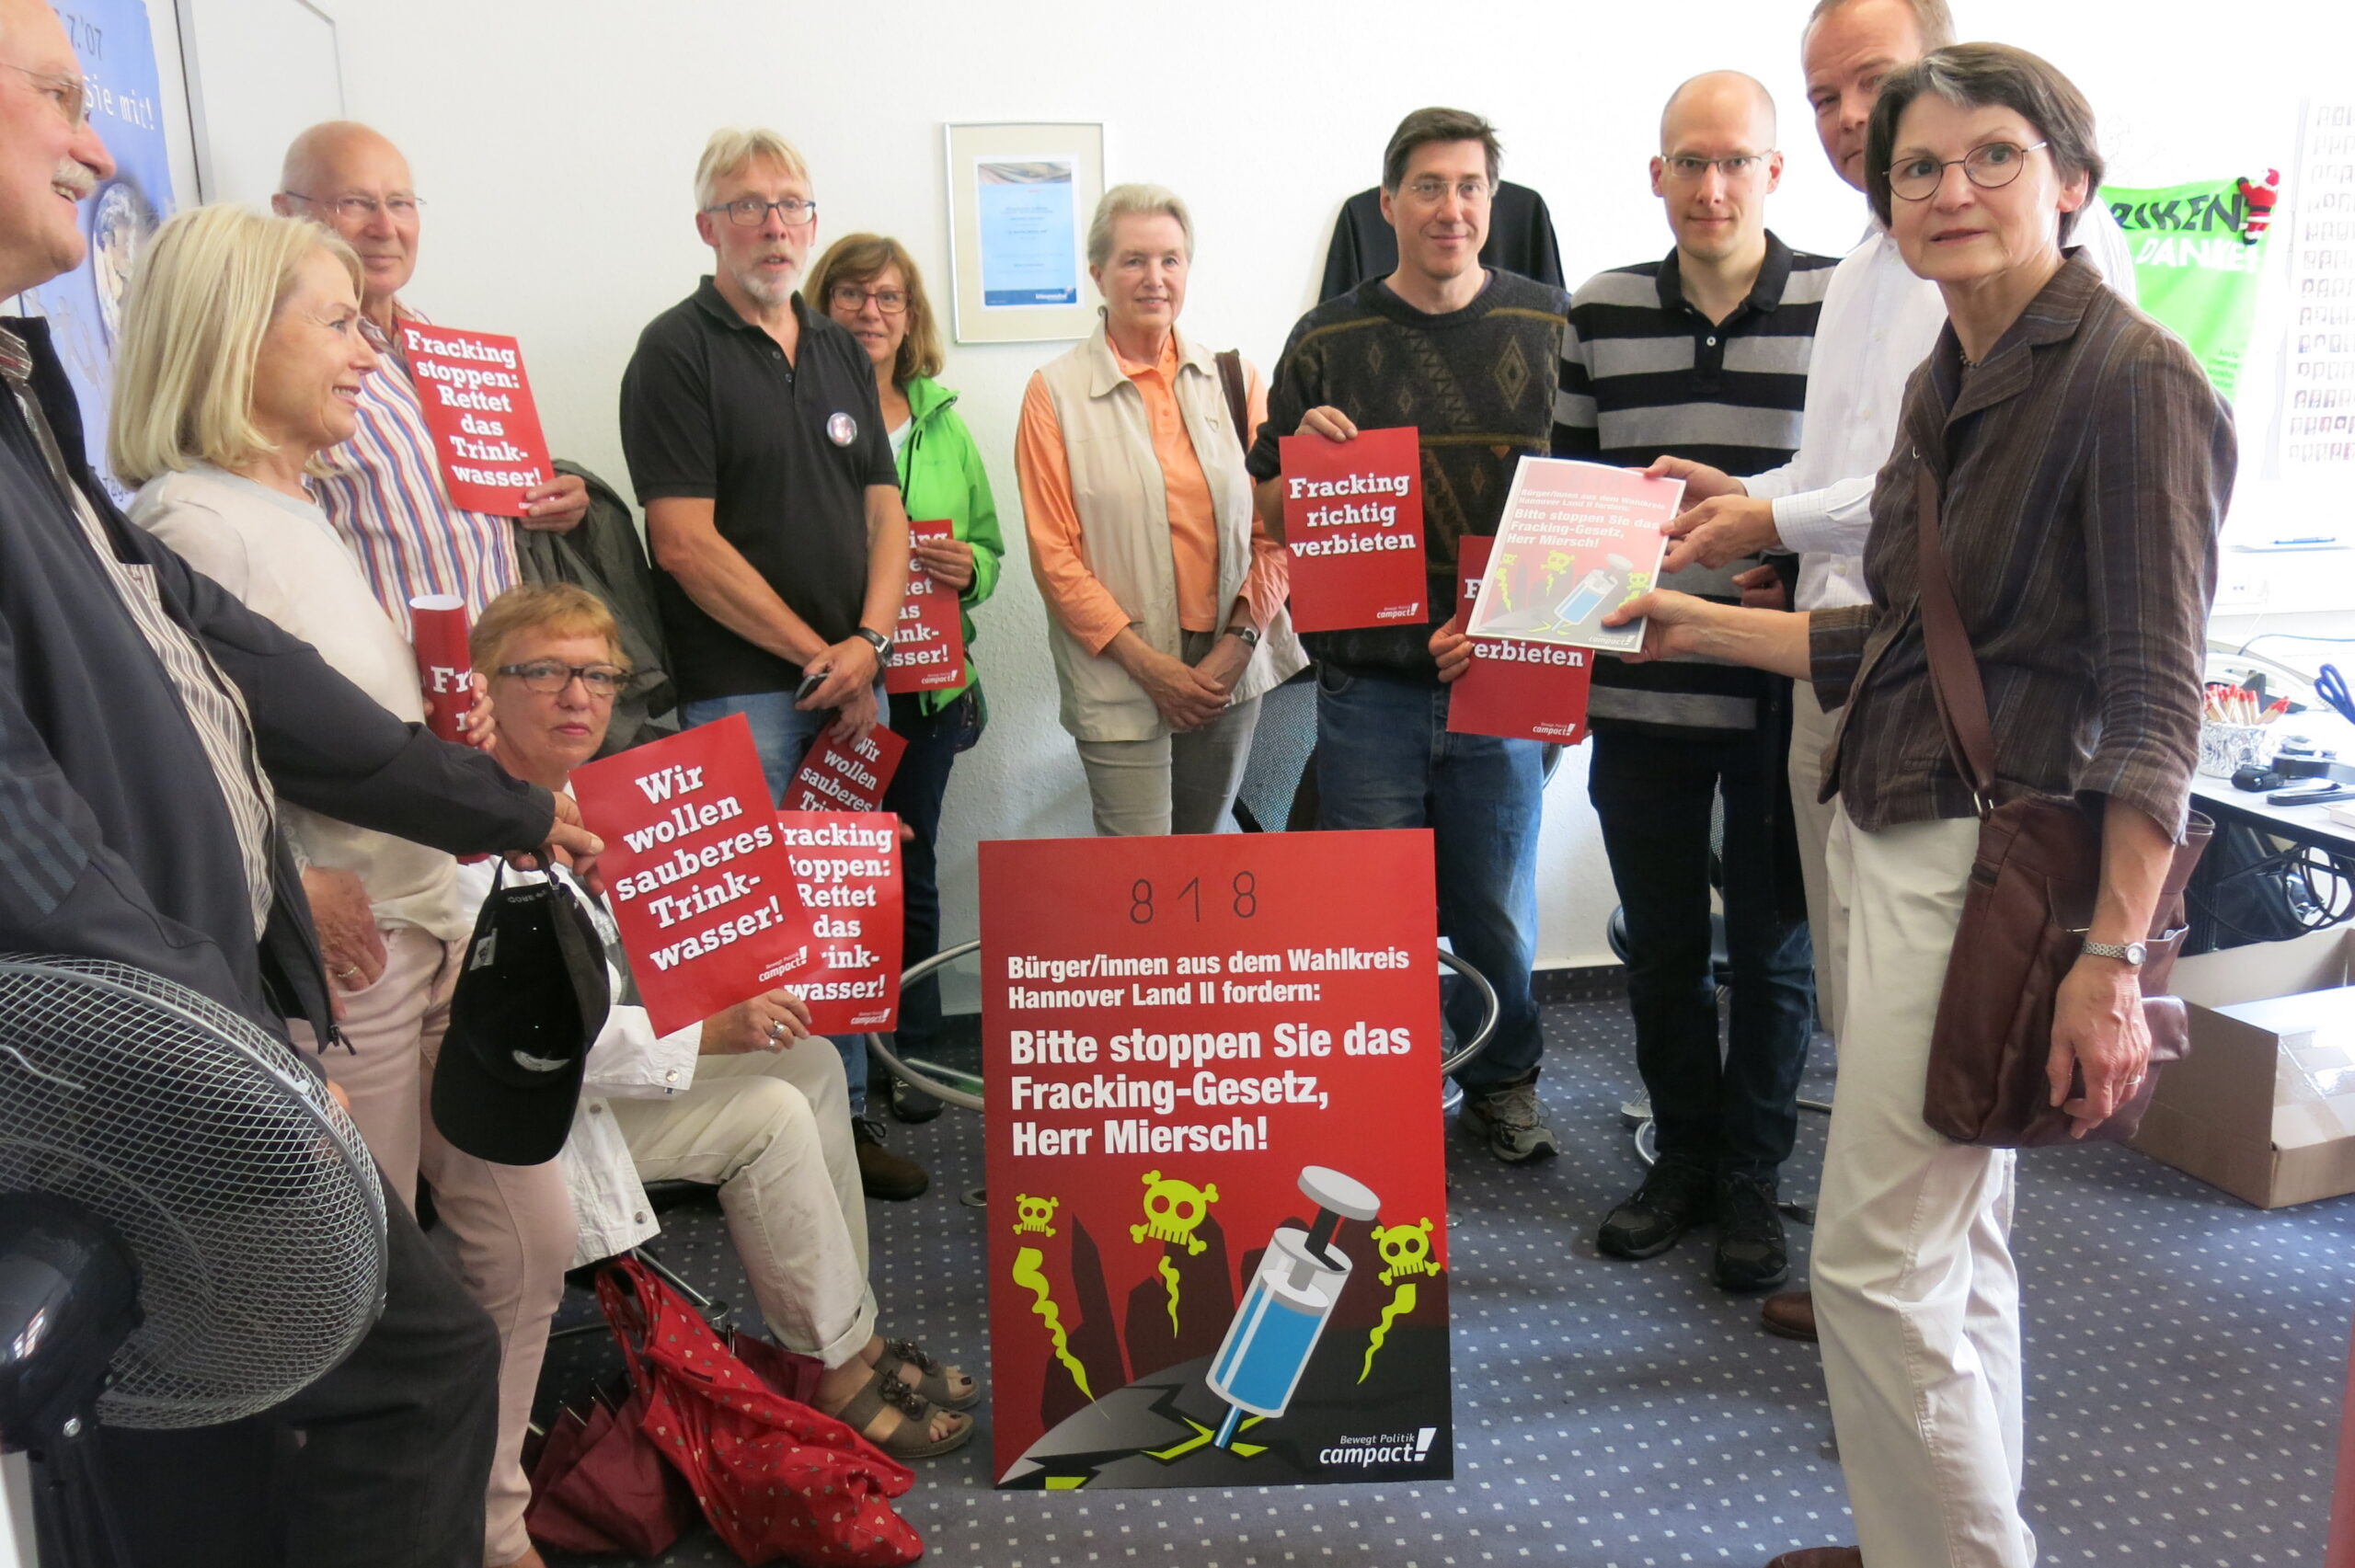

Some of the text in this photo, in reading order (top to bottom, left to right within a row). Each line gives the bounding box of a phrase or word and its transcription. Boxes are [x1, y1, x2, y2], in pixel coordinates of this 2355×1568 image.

[119, 90, 155, 131] mit!
[2110, 193, 2243, 232] RIKEN
[404, 328, 515, 369] Fracking
[416, 360, 520, 390] stoppen:
[437, 384, 512, 413] Rettet
[461, 414, 504, 437] das
[449, 435, 529, 462] Trink-
[451, 465, 543, 487] wasser!
[1289, 473, 1410, 499] Fracking
[1519, 498, 1560, 506] Hannover
[1580, 493, 1597, 501] aus
[1600, 494, 1619, 503] dem
[1306, 502, 1396, 527] richtig
[1515, 509, 1660, 531] Bitte stoppen Sie das
[1507, 532, 1600, 548] Herr Miersch!
[1511, 521, 1625, 539] Fracking-Gesetz,
[1290, 532, 1416, 557] verbieten
[898, 605, 921, 619] as
[892, 624, 939, 643] ink-
[887, 644, 948, 667] sser!
[1472, 640, 1584, 667] erbieten
[855, 737, 880, 762] Wir
[824, 750, 877, 790] wollen
[635, 765, 704, 805] Wir
[800, 767, 873, 811] sauberes
[623, 795, 742, 853] wollen
[615, 824, 773, 901] sauberes
[649, 871, 761, 929] Trink-
[797, 883, 877, 908] Rettet
[649, 895, 784, 971] wasser!
[812, 914, 862, 938] das
[758, 945, 808, 982] campact!
[820, 944, 880, 968] ink-
[1007, 946, 1409, 983] Bürger/innen aus dem Wahlkreis
[784, 974, 886, 1001] wasser!
[1008, 979, 1321, 1010] Hannover Land II fordern:
[1010, 1021, 1411, 1068] Bitte stoppen Sie das
[1011, 1070, 1329, 1116] Fracking-Gesetz,
[1013, 1116, 1269, 1156] Herr Miersch!
[1319, 1427, 1437, 1468] campact!
[1339, 1433, 1415, 1445] Bewegt Politik
